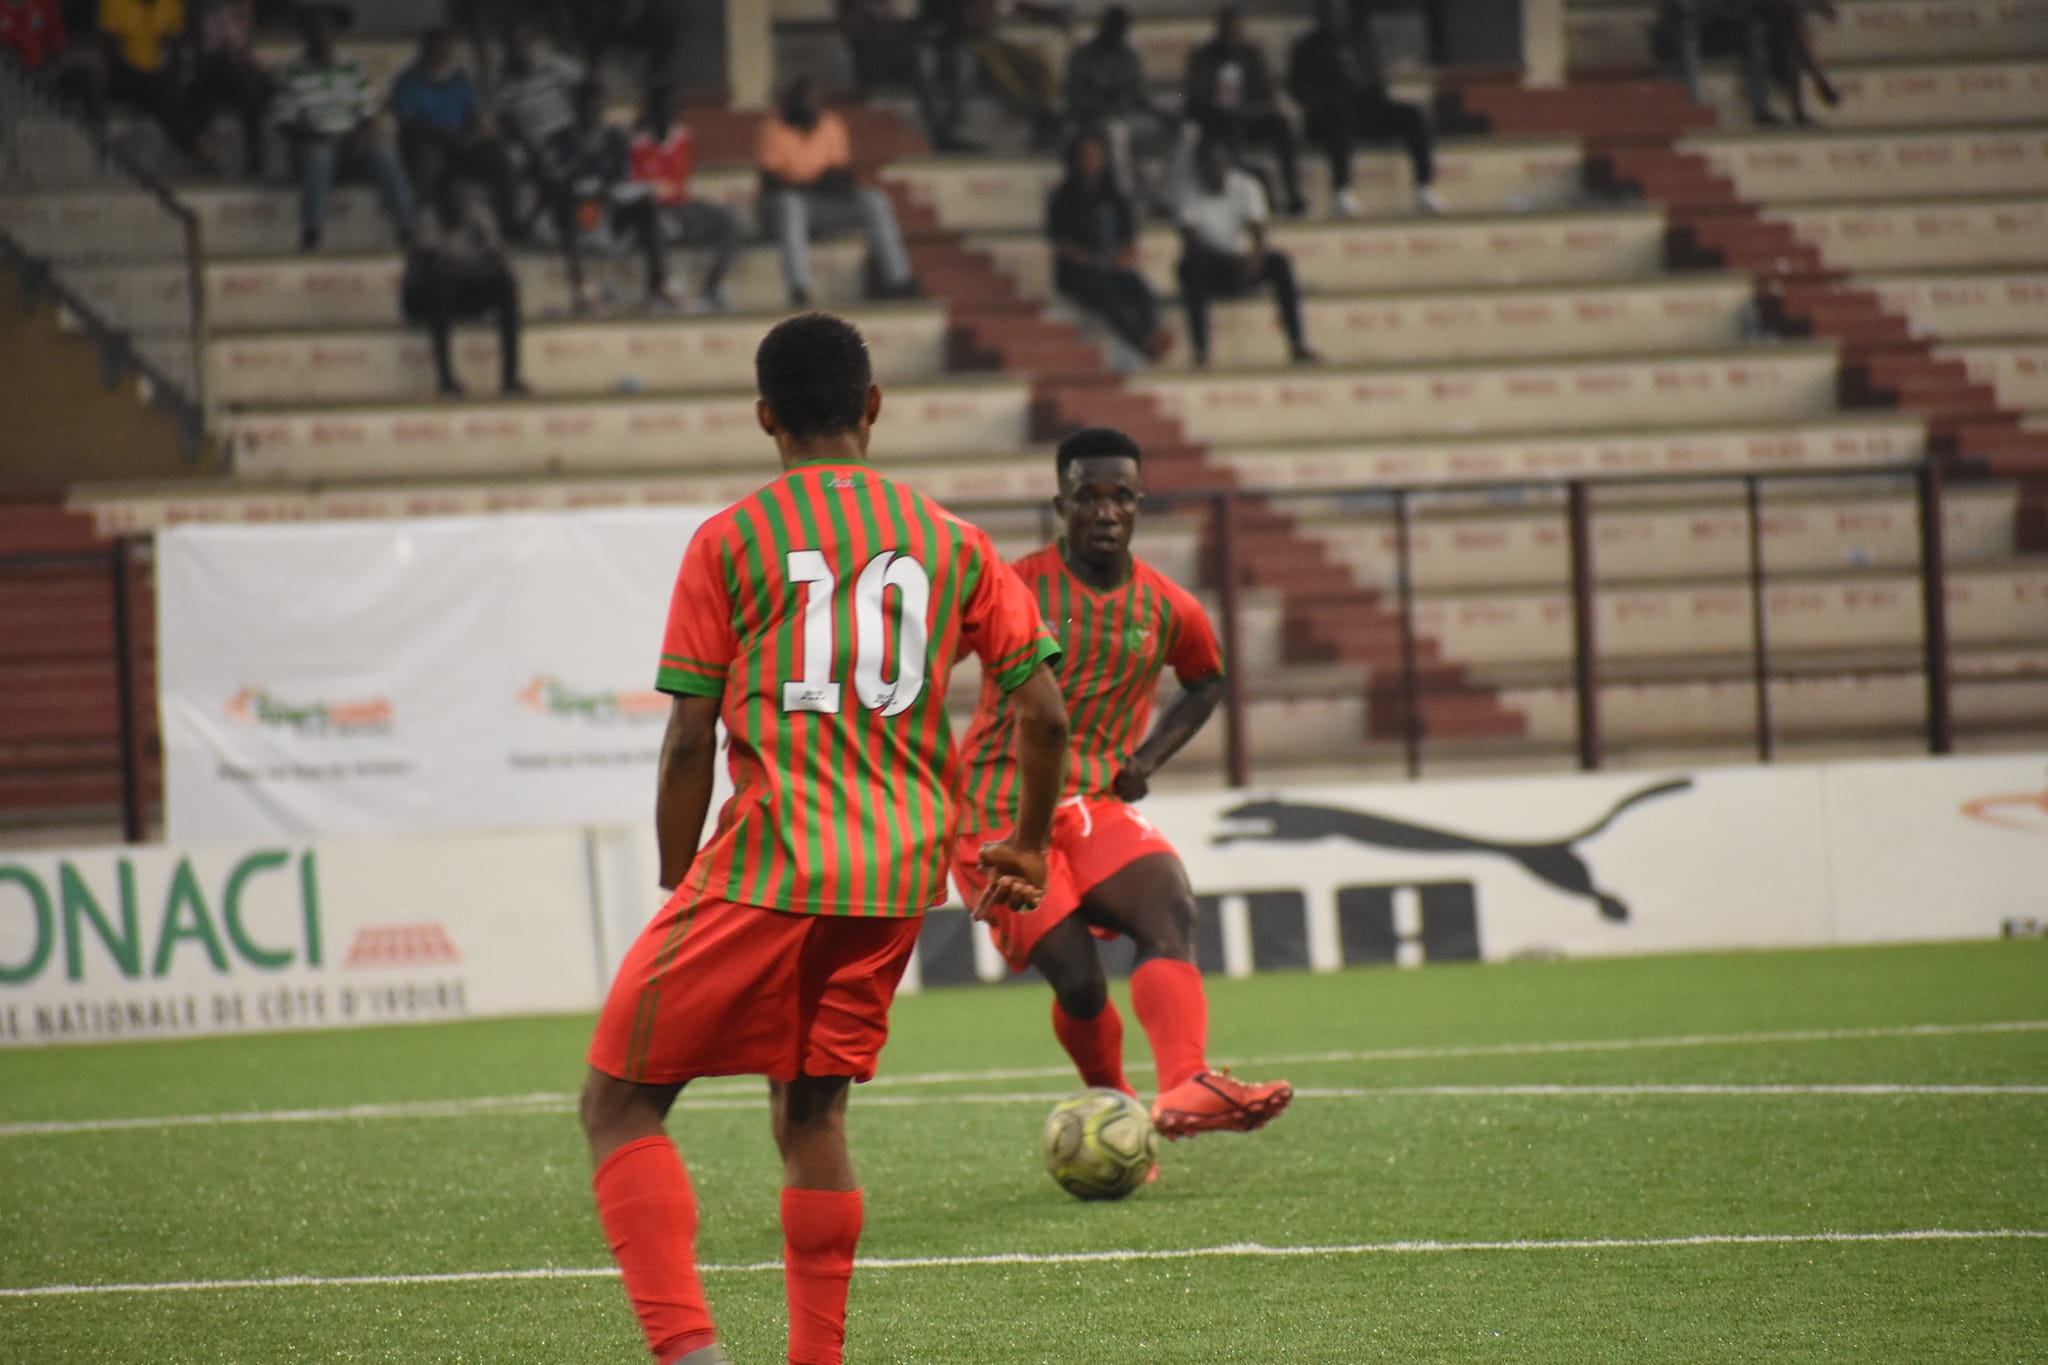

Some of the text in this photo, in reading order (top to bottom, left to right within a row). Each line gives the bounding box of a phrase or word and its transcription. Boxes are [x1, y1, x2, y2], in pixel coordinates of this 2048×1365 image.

[783, 549, 931, 718] 10
[34, 994, 197, 1037] NATIONALE
[210, 990, 244, 1024] DE
